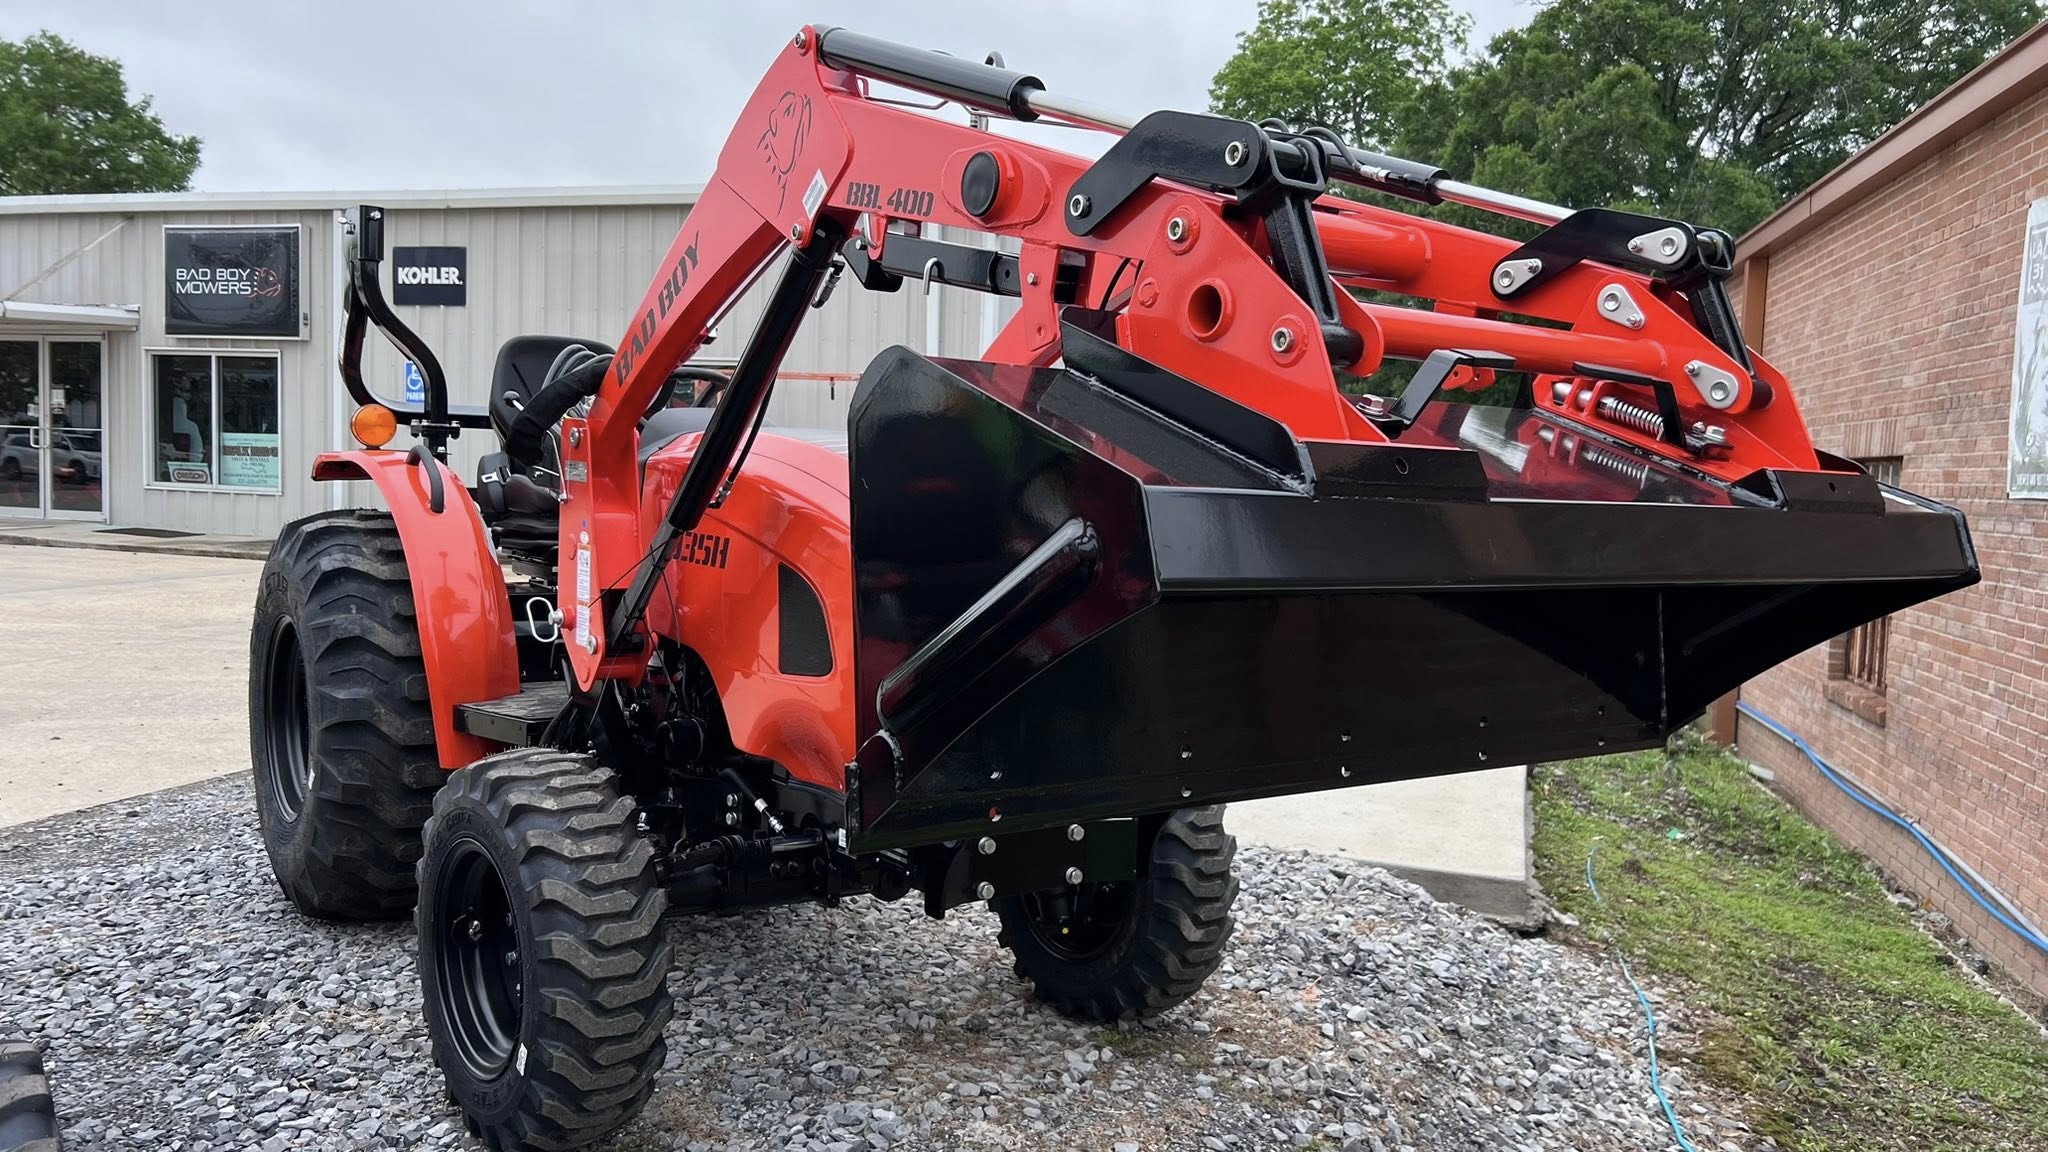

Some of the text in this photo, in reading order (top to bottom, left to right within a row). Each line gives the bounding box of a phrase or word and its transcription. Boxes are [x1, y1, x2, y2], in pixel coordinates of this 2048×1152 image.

[846, 182, 882, 210] BBL
[887, 188, 934, 217] 400
[176, 268, 251, 280] BAD BOY
[176, 281, 251, 294] MOWERS
[615, 230, 699, 388] BAD BOY
